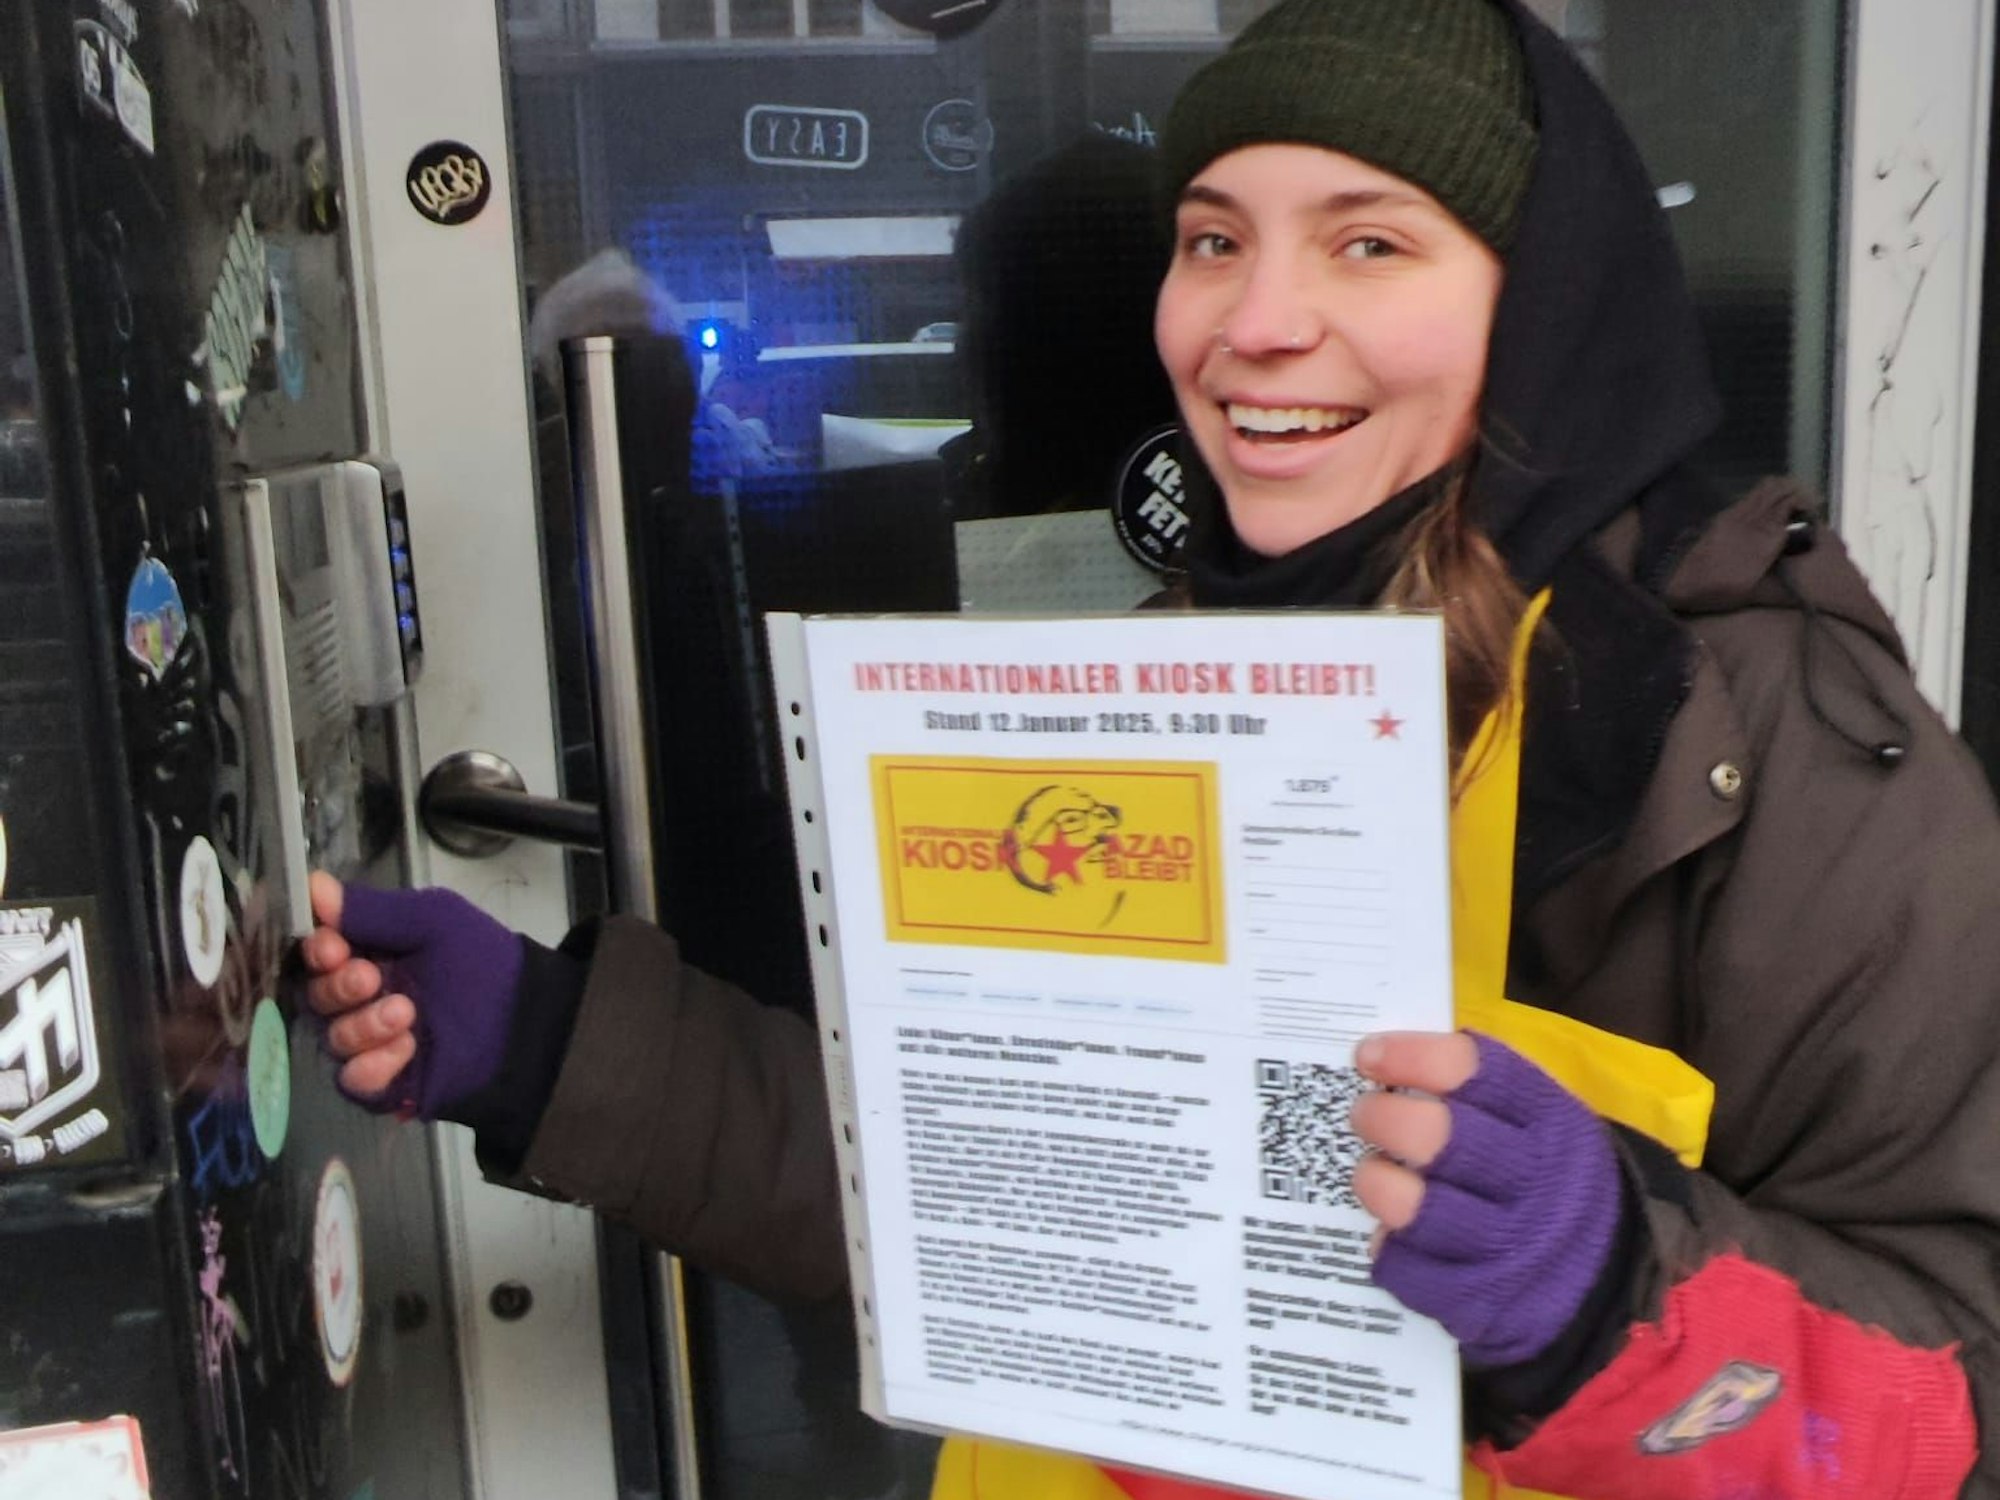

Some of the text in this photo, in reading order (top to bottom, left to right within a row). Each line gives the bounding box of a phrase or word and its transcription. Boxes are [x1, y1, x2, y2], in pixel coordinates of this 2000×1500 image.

[853, 661, 1376, 697] INTERNATIONALER KIOSK BLEIBT!
[923, 709, 981, 732] Stand
[1227, 712, 1267, 736] Uhr
[1104, 833, 1194, 861] AZAD
[1104, 859, 1194, 882] BLEIBT
